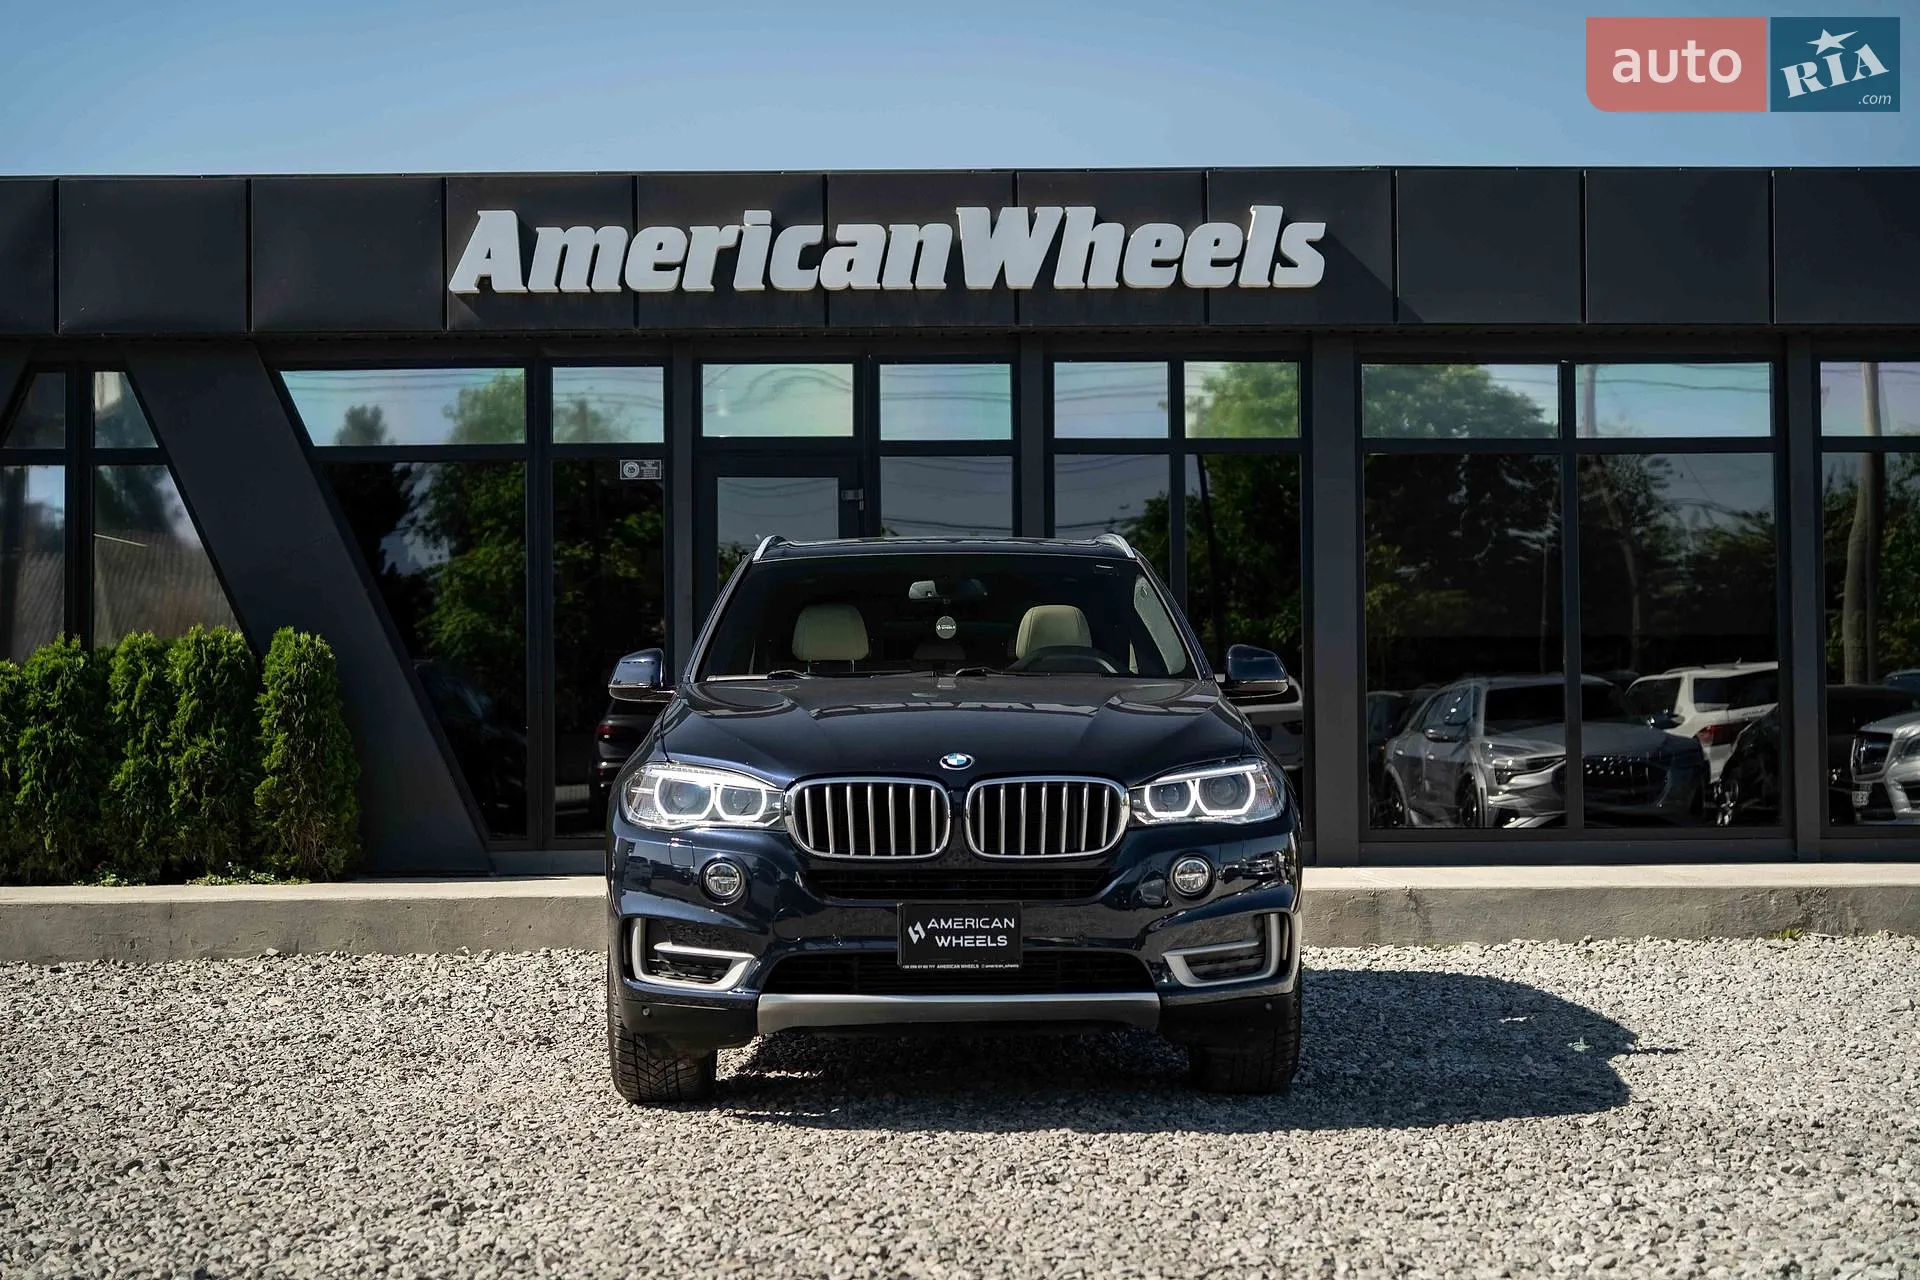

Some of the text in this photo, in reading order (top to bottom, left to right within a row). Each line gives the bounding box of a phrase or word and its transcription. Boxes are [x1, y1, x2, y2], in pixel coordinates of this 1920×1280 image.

[448, 205, 1327, 294] AmericanWheels
[927, 917, 1015, 929] AMERICAN
[935, 935, 1008, 947] WHEELS
